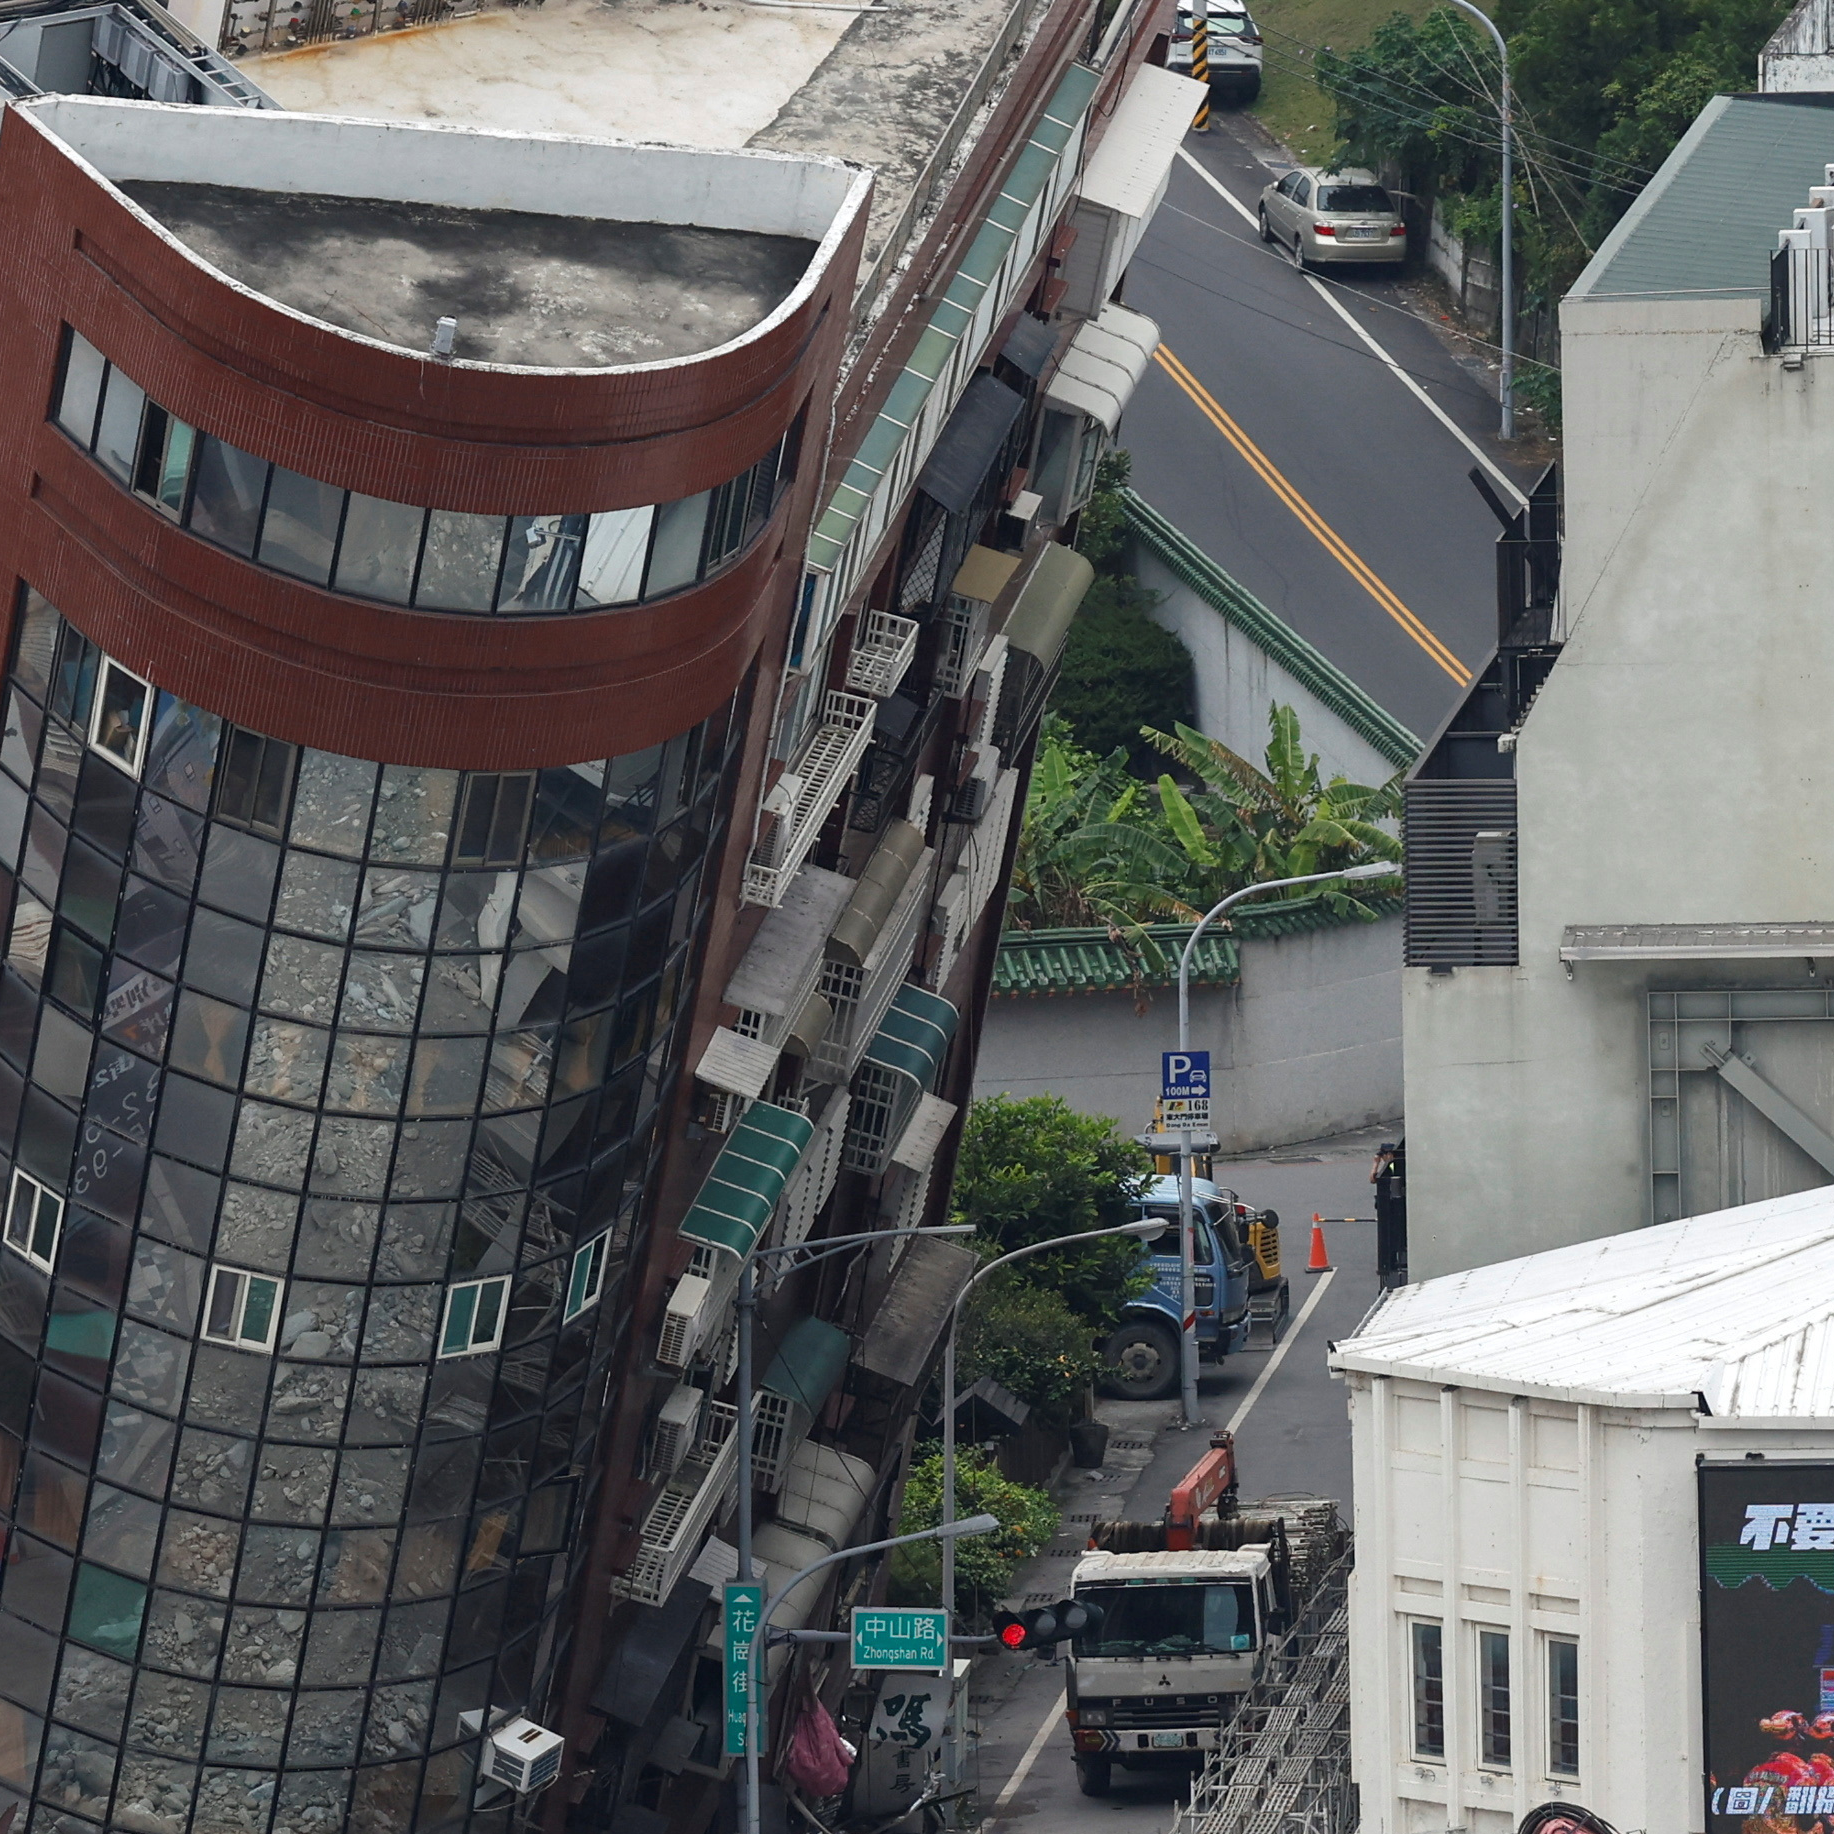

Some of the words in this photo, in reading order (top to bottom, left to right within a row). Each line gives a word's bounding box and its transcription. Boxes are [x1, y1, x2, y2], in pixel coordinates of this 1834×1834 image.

[1169, 1055, 1191, 1084] P
[1165, 1086, 1190, 1098] 100M
[1188, 1099, 1209, 1112] 168
[864, 1617, 937, 1641] 中山路
[730, 1610, 756, 1695] 花崗街
[863, 1645, 918, 1662] Zhongshan
[919, 1645, 937, 1660] Rd.
[1112, 1694, 1218, 1708] FUSO
